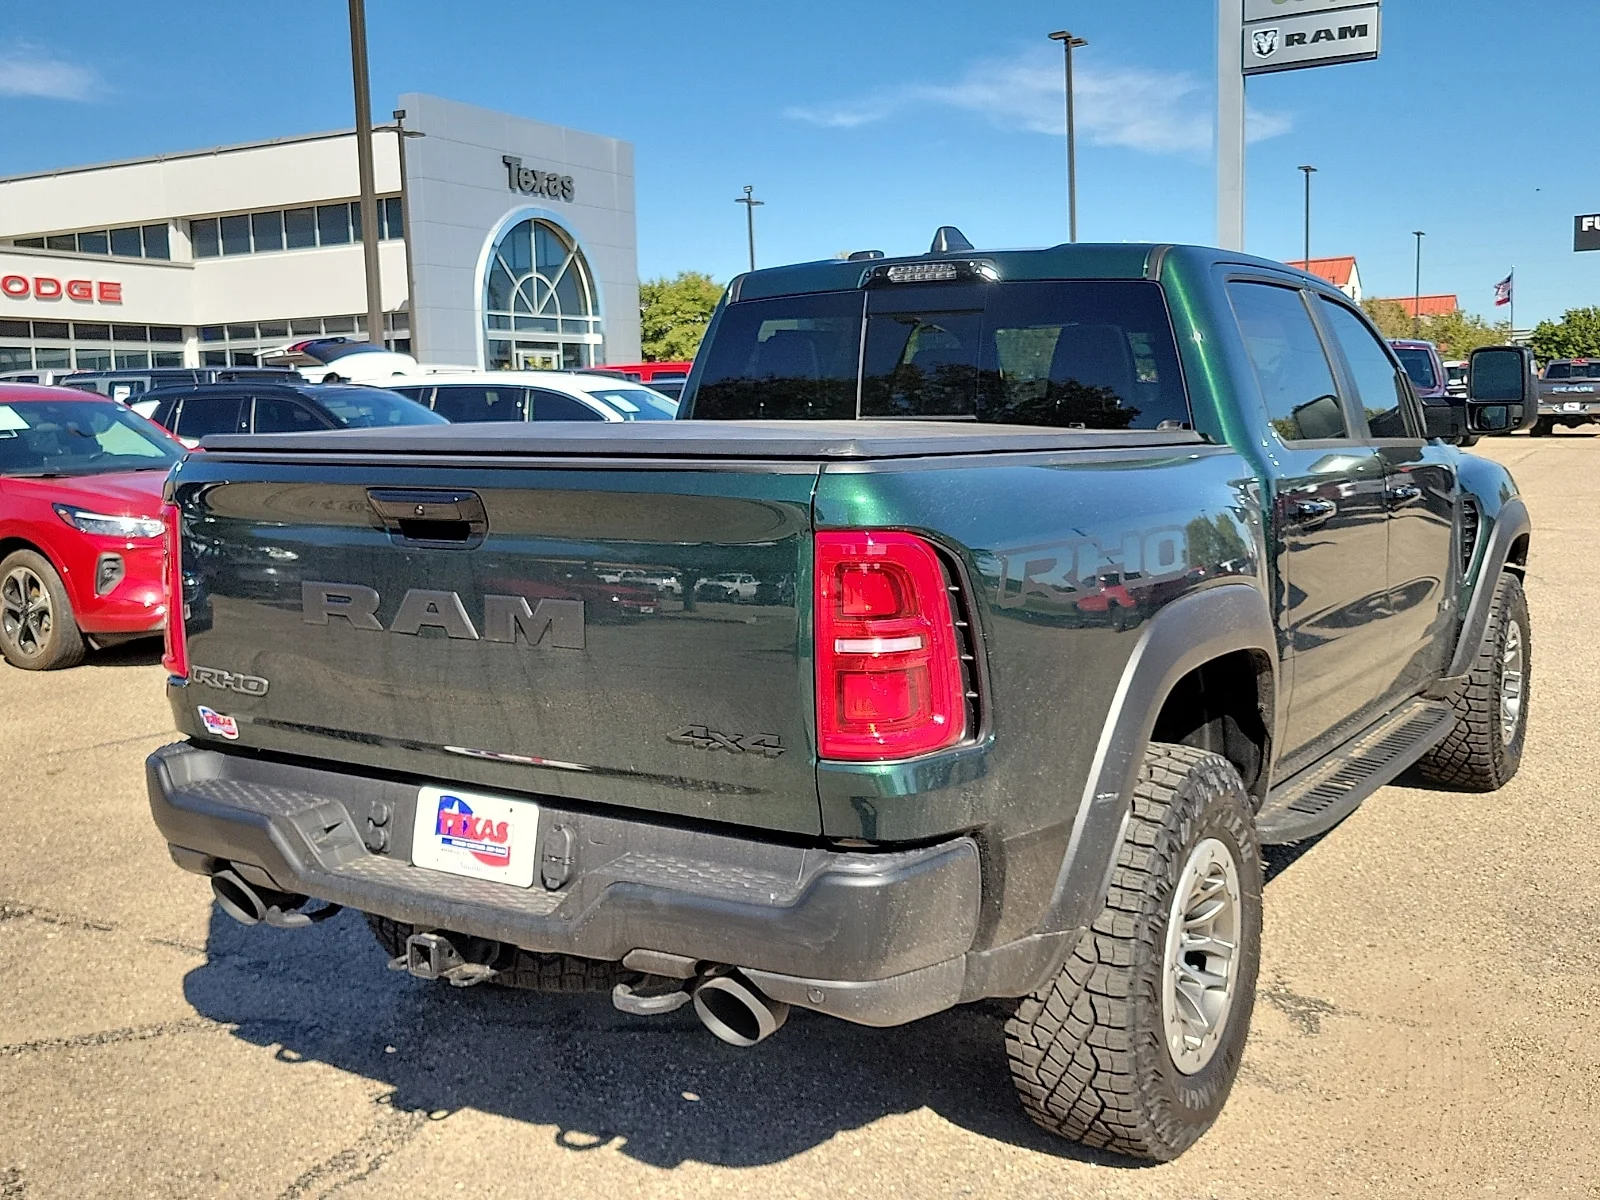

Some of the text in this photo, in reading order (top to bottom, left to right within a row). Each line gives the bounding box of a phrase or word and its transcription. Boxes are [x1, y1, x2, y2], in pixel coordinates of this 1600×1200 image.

[1285, 24, 1368, 47] RAM
[502, 155, 574, 200] Texas
[1, 275, 122, 304] ODGE
[992, 525, 1190, 609] RHO
[301, 580, 586, 650] RAM
[192, 665, 269, 697] RHO
[440, 809, 509, 844] TEXAS
